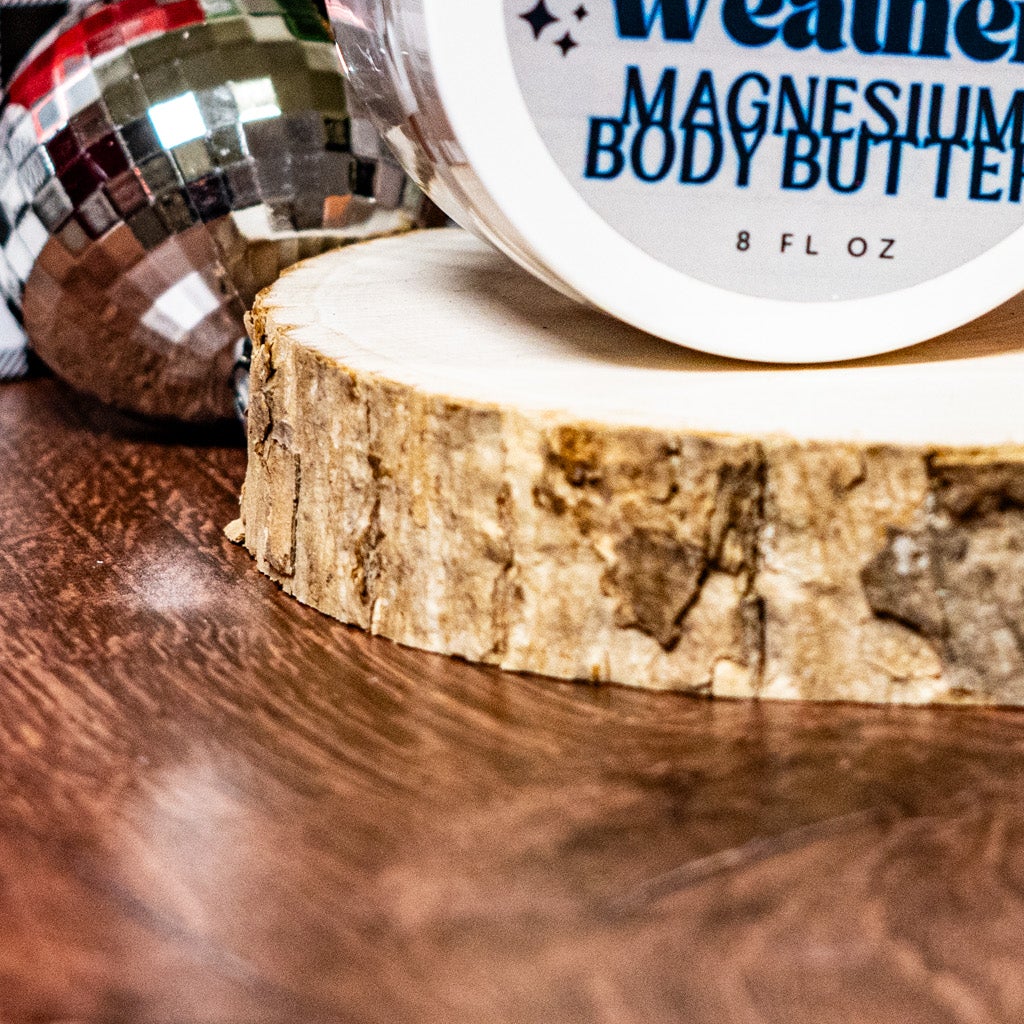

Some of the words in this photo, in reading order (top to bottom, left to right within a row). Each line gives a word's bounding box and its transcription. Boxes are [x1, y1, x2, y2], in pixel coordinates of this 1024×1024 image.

[583, 114, 768, 188] BODY
[736, 230, 751, 252] 8
[780, 232, 819, 256] FL
[847, 236, 896, 260] OZ
